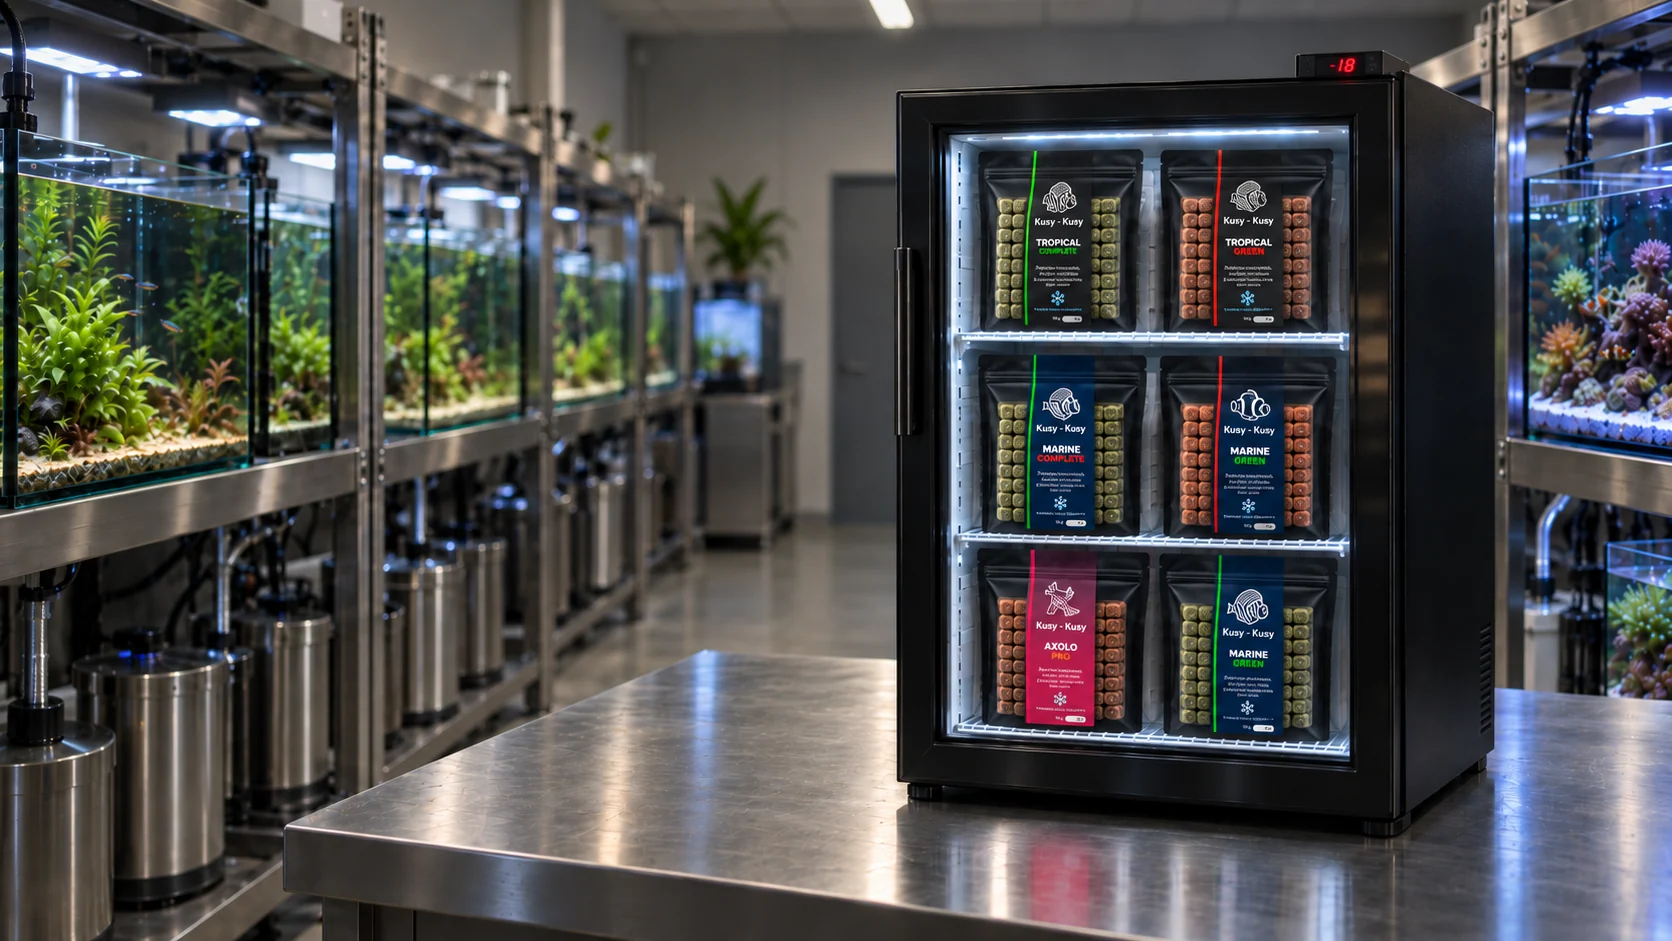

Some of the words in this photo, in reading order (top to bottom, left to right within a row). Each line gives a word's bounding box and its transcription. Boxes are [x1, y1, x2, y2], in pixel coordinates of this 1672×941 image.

[1329, 58, 1355, 73] -18
[1034, 217, 1056, 228] Kusy
[1062, 217, 1084, 228] Kusy
[1223, 216, 1245, 227] Kusy
[1252, 216, 1274, 227] Kusy
[1035, 238, 1081, 247] TROPICAL
[1225, 238, 1273, 247] TROPICAL
[1036, 424, 1058, 434] Kusy
[1223, 425, 1247, 436] Kusy
[1253, 425, 1275, 437] Kusy
[1042, 445, 1081, 454] MARINE
[1230, 446, 1270, 456] MARINE
[1036, 621, 1058, 632] Kusy
[1065, 622, 1087, 633] Kusy
[1222, 627, 1245, 639] Kusy
[1252, 628, 1275, 640] Kusy
[1044, 642, 1078, 652] AXOLO
[1051, 651, 1071, 661] PRO
[1229, 649, 1269, 659] MARINE
